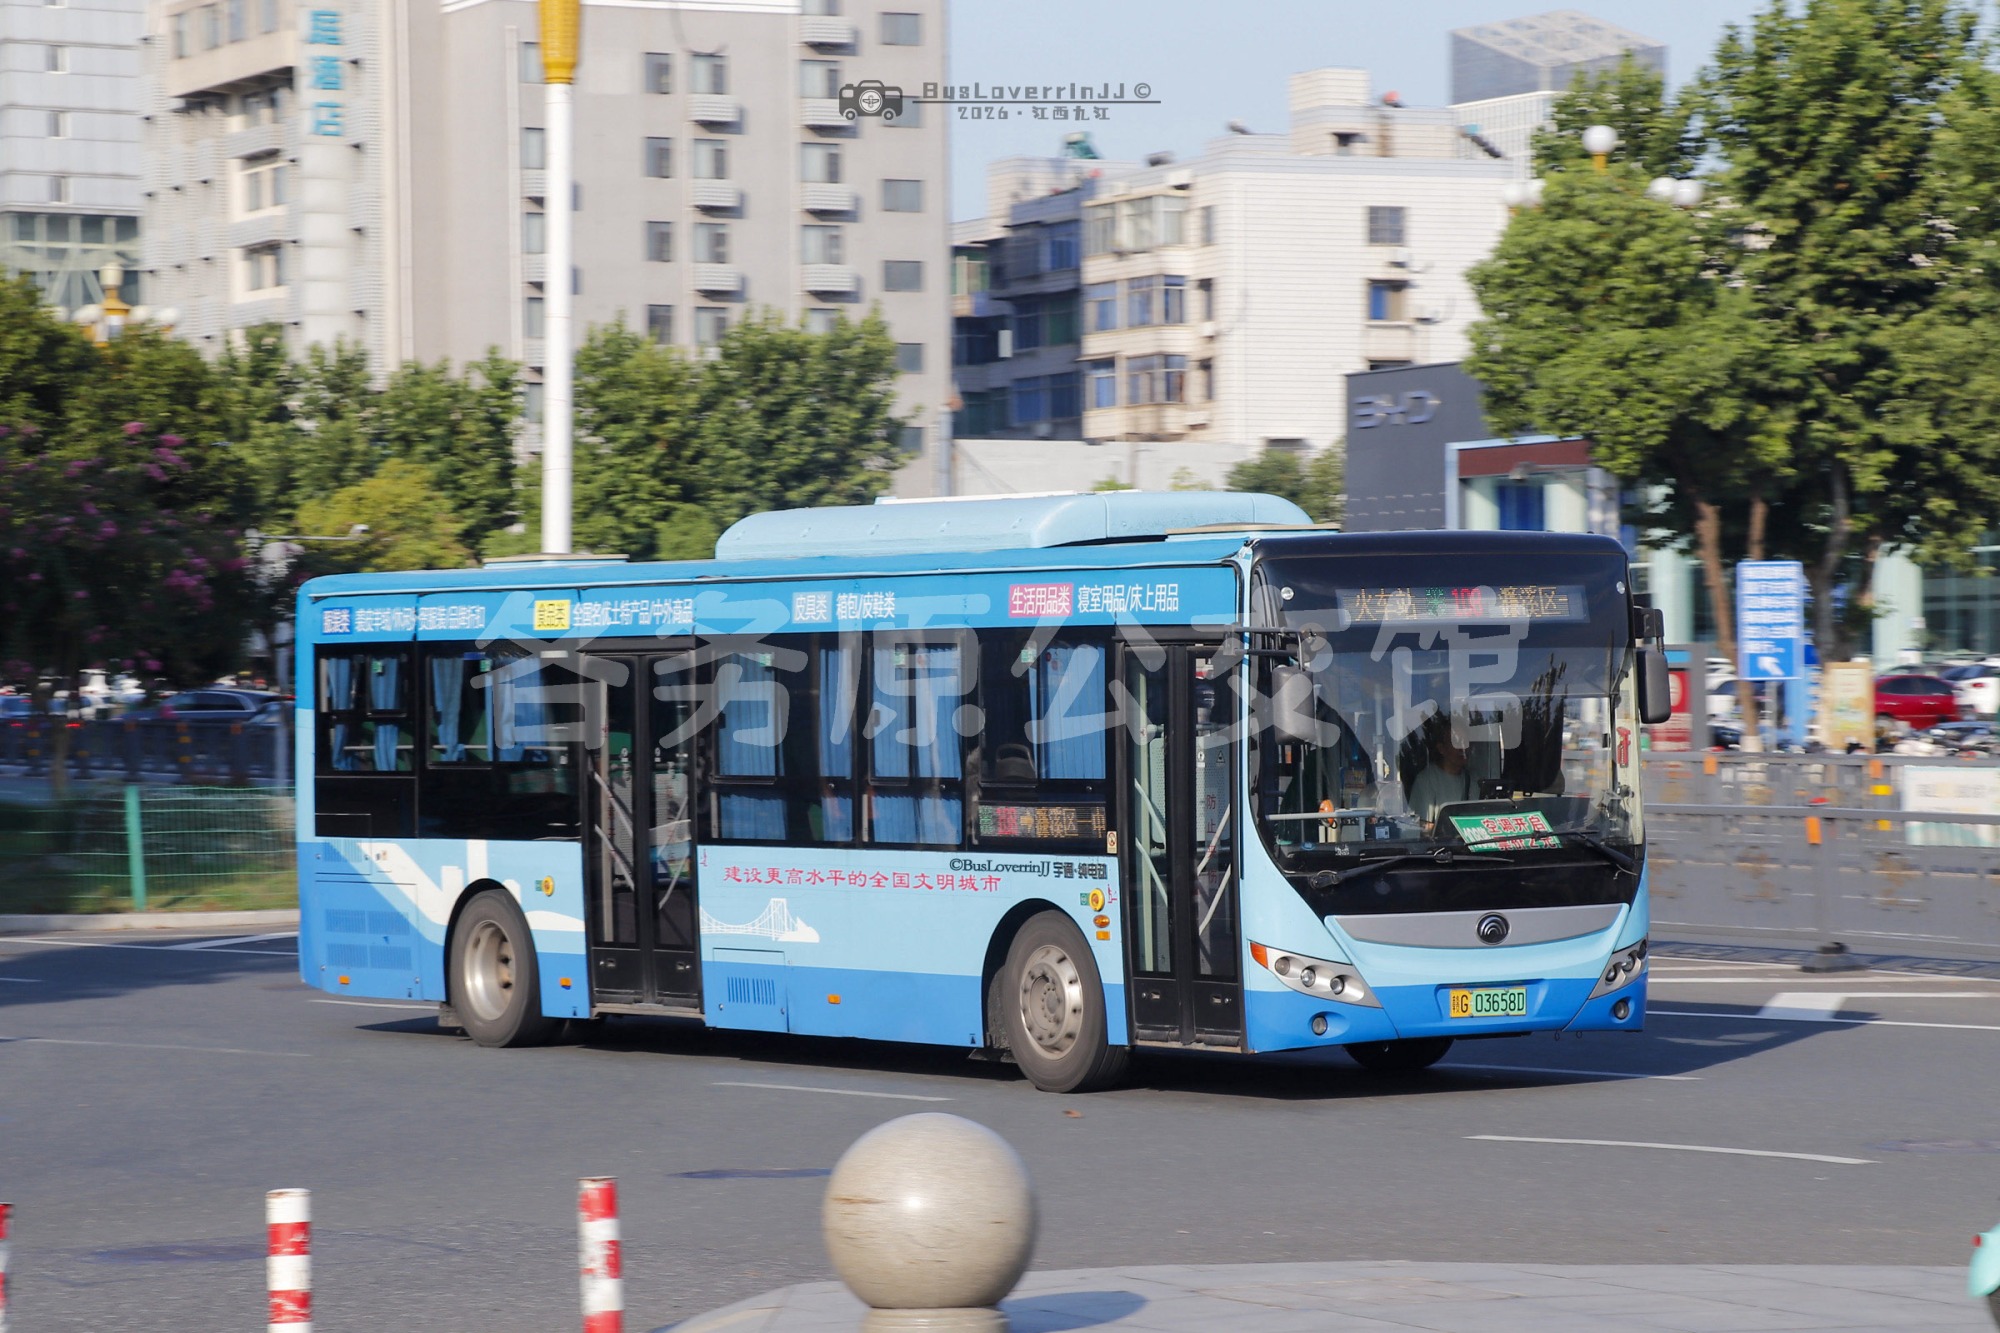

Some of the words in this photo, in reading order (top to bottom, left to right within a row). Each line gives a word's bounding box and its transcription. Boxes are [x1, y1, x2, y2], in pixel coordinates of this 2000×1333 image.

[1353, 391, 1440, 429] BYD
[794, 594, 828, 621] 皮具类
[836, 591, 896, 620] 箱包/皮鞋类
[1011, 585, 1071, 616] 生活用品类
[1077, 583, 1179, 613] 寝室用品/床上用品
[537, 602, 567, 628] 食品类
[1482, 814, 1547, 834] 空调开启
[722, 866, 1002, 892] 建设更高水平的全国文明城市
